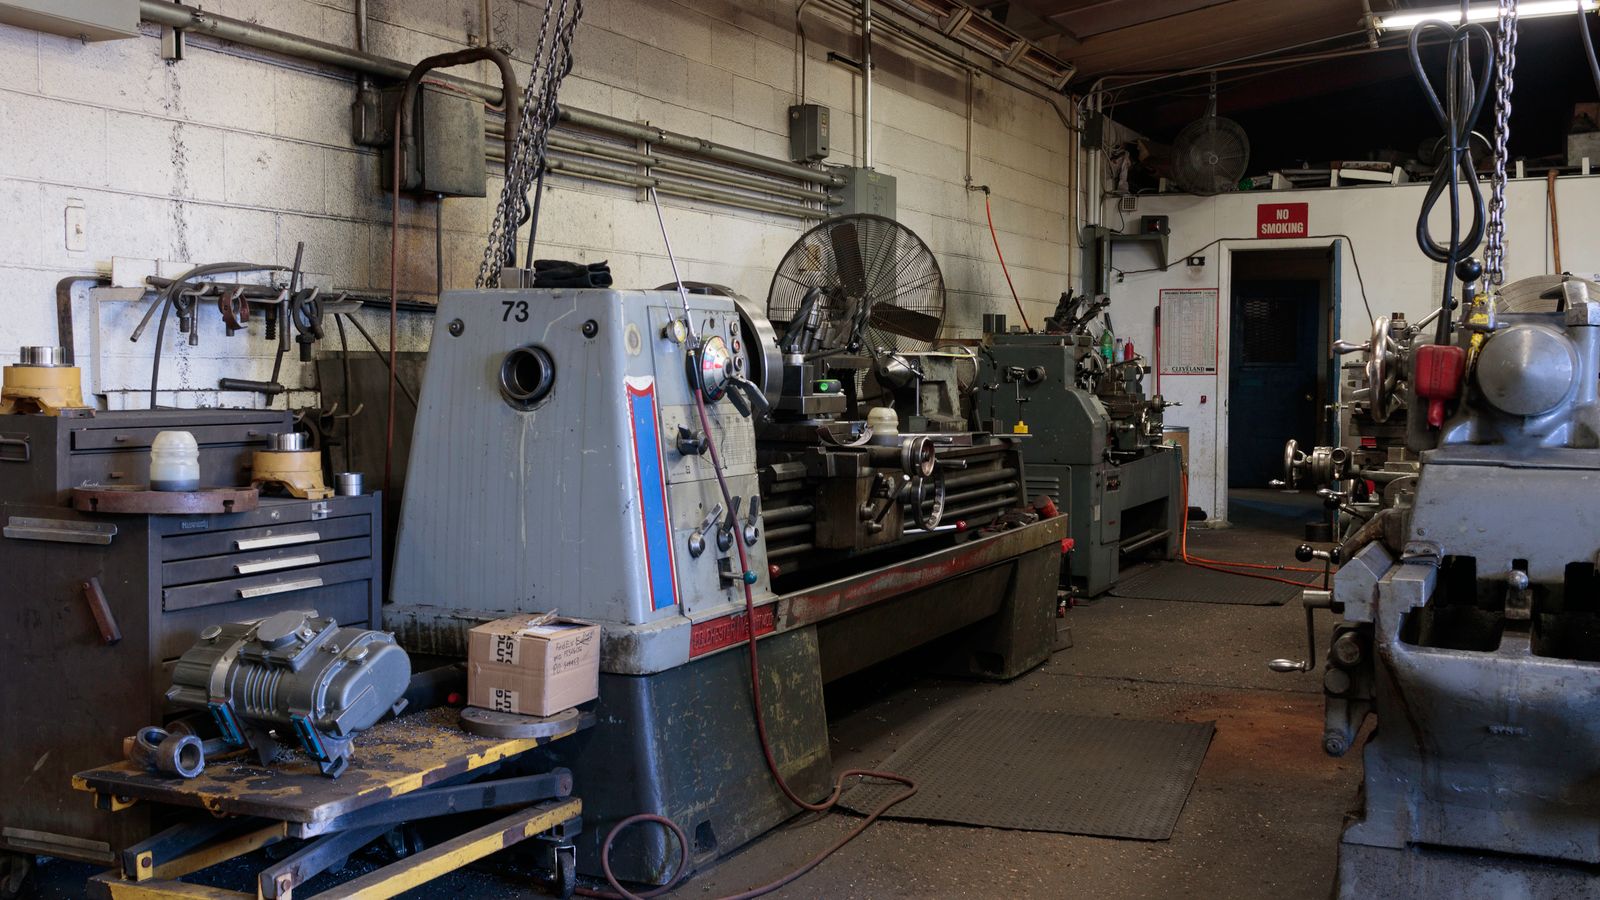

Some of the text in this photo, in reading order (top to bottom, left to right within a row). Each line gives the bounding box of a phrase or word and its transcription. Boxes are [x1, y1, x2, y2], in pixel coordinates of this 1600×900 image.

[1276, 208, 1289, 220] NO
[1261, 222, 1304, 234] SMOKING
[502, 300, 529, 323] 73
